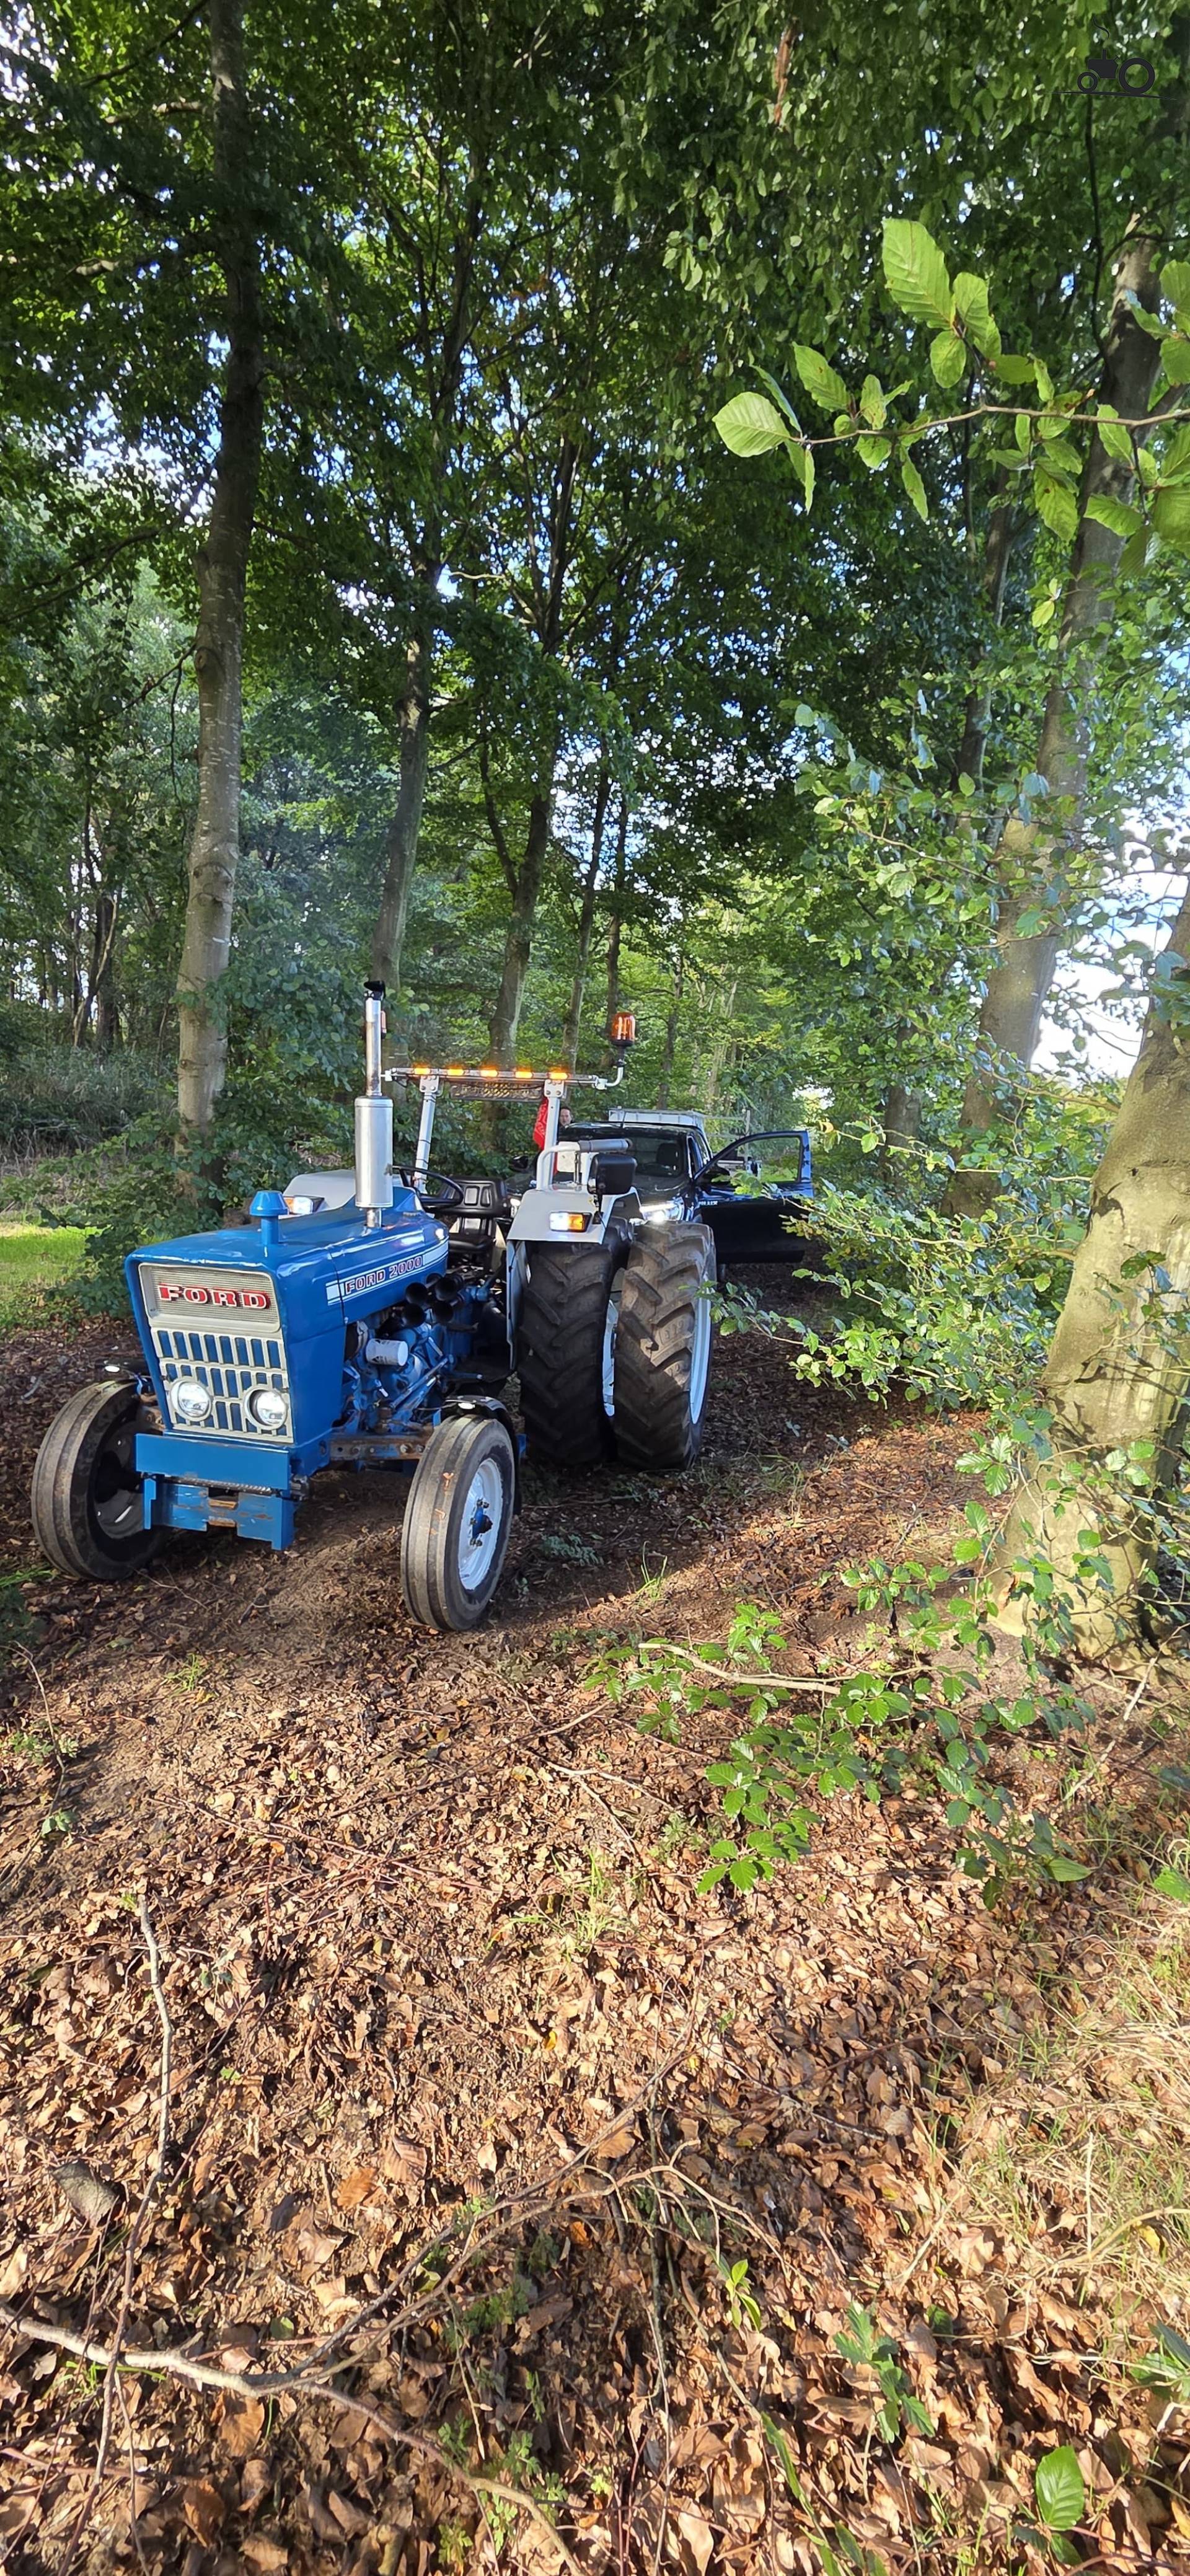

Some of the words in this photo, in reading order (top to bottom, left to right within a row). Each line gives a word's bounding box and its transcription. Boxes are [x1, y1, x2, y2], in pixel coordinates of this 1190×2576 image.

[345, 1269, 386, 1295] FORD
[389, 1255, 422, 1279] 2000
[158, 1282, 271, 1309] FORD
